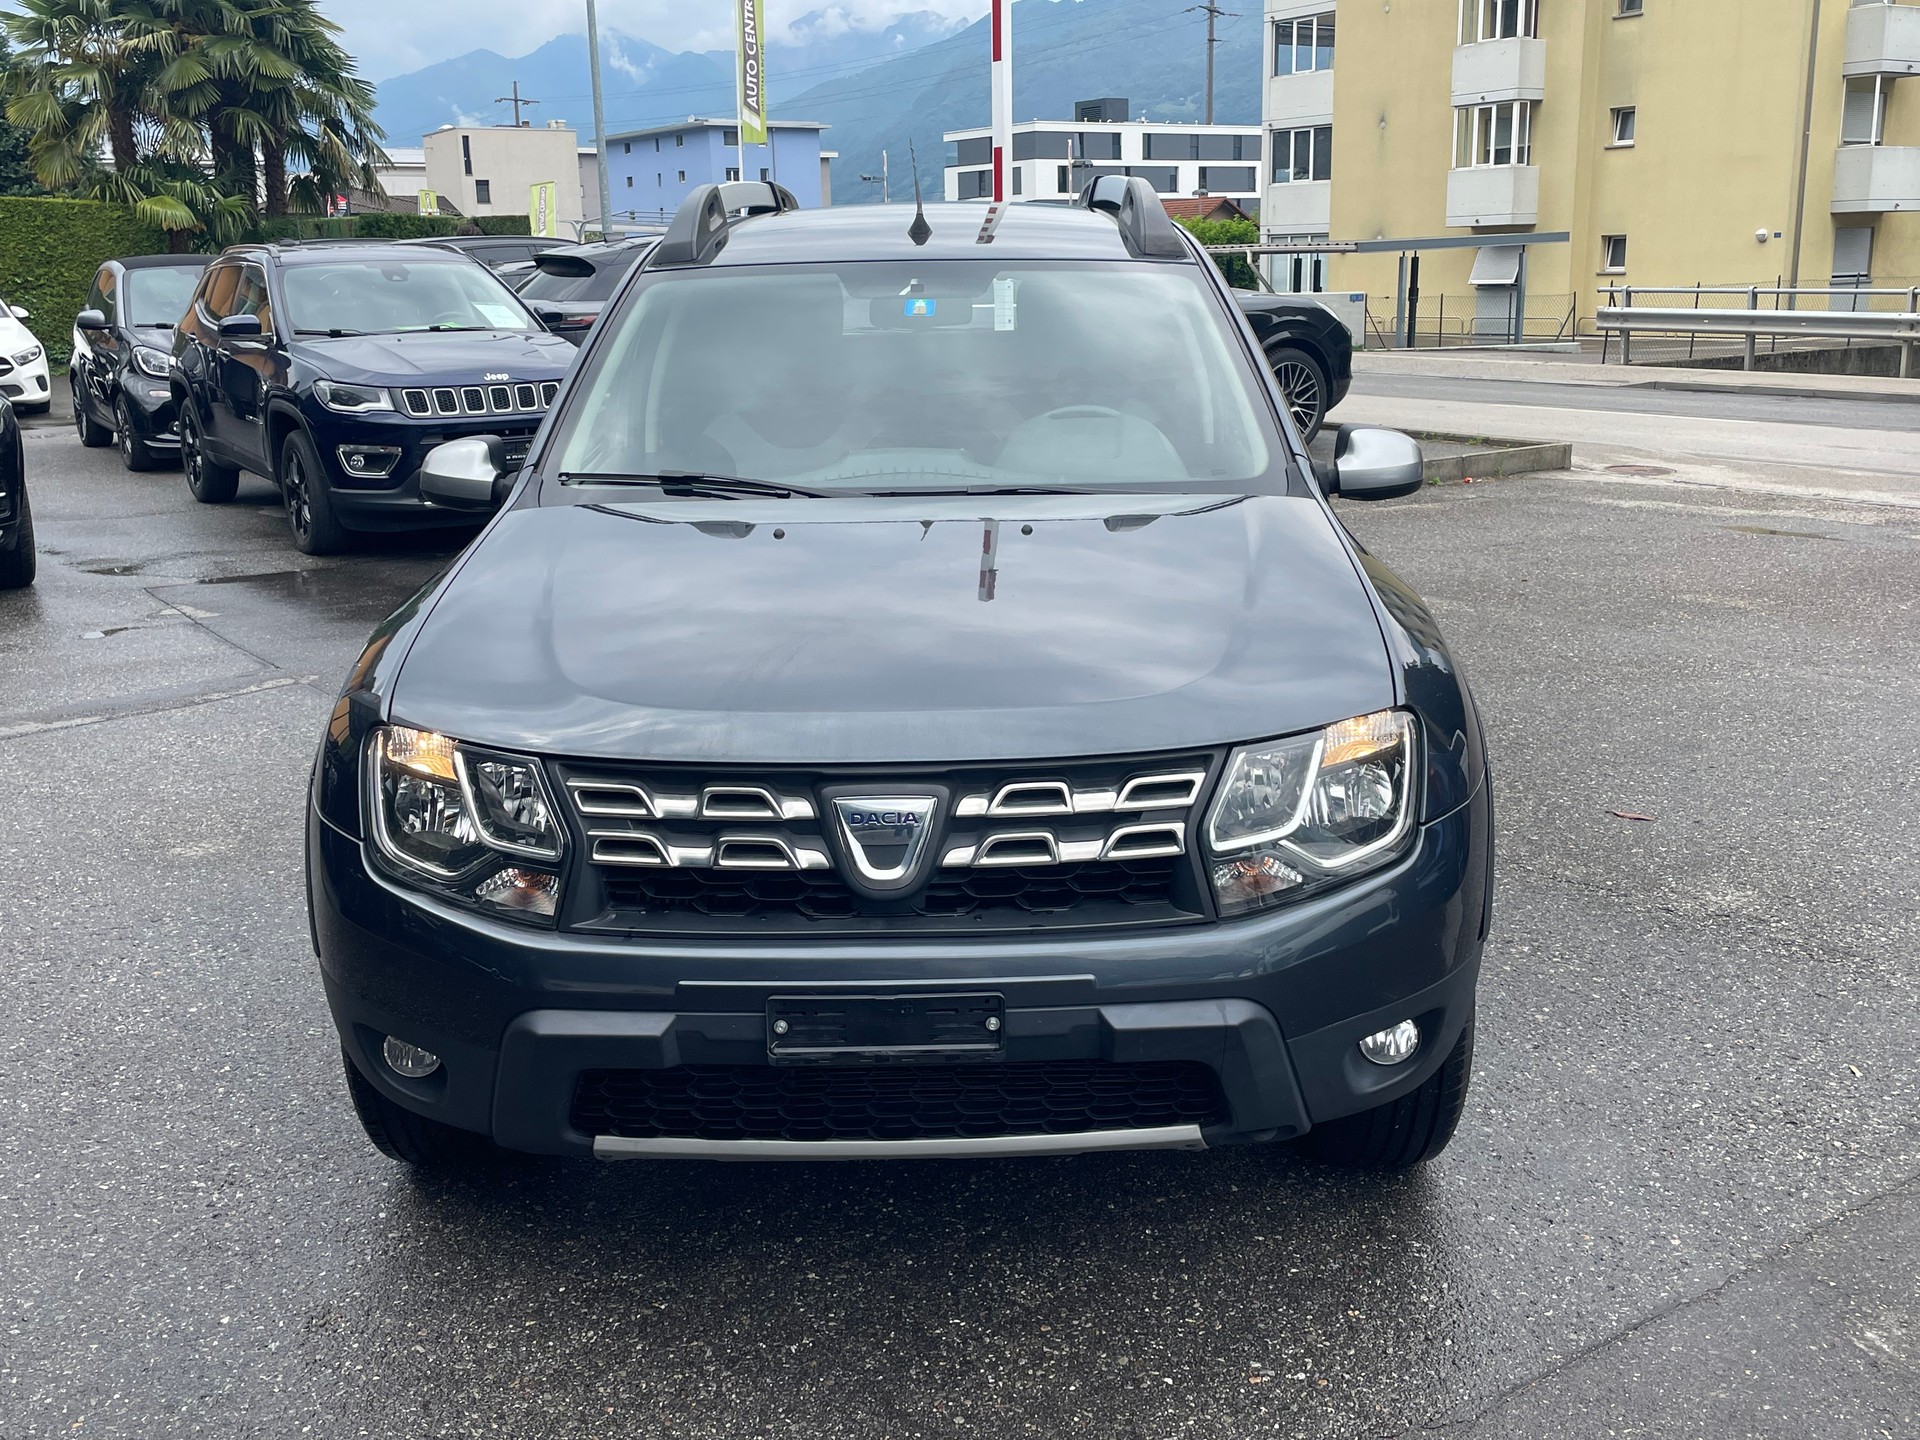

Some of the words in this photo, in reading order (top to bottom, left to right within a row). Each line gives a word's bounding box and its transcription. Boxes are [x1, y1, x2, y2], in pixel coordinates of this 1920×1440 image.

[746, 59, 759, 110] AUTO
[483, 372, 510, 381] Jeep
[849, 812, 919, 825] DACIA
